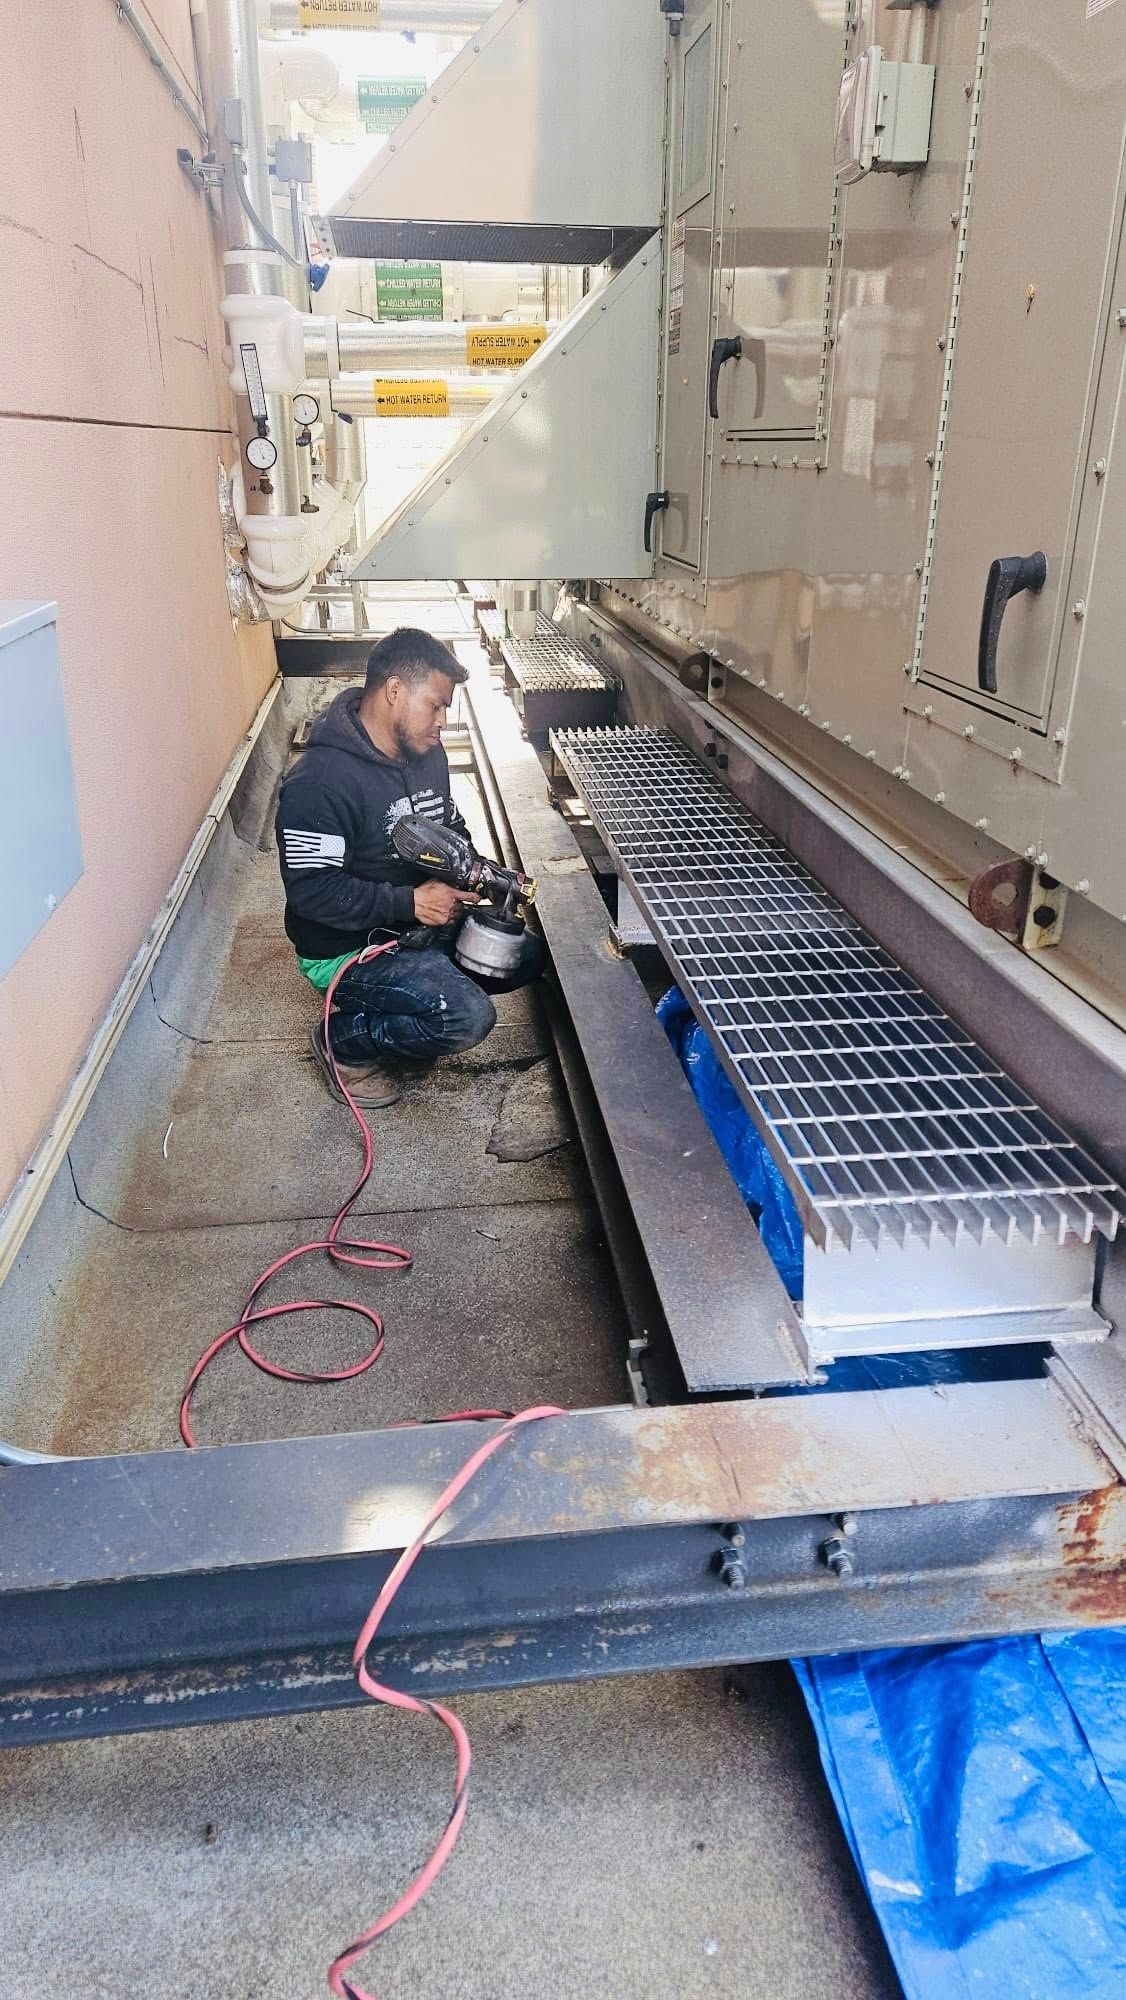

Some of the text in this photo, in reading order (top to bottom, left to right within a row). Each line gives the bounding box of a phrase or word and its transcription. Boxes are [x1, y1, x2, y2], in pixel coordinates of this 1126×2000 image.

[339, 0, 362, 12] WATER
[364, 1, 378, 13] HOT
[386, 279, 406, 288] CHILLED
[472, 336, 529, 347] HOT WATER SUPPLY
[472, 357, 484, 366] HOT
[485, 357, 506, 366] WATER
[386, 393, 447, 405] HOT WATER RETURN
